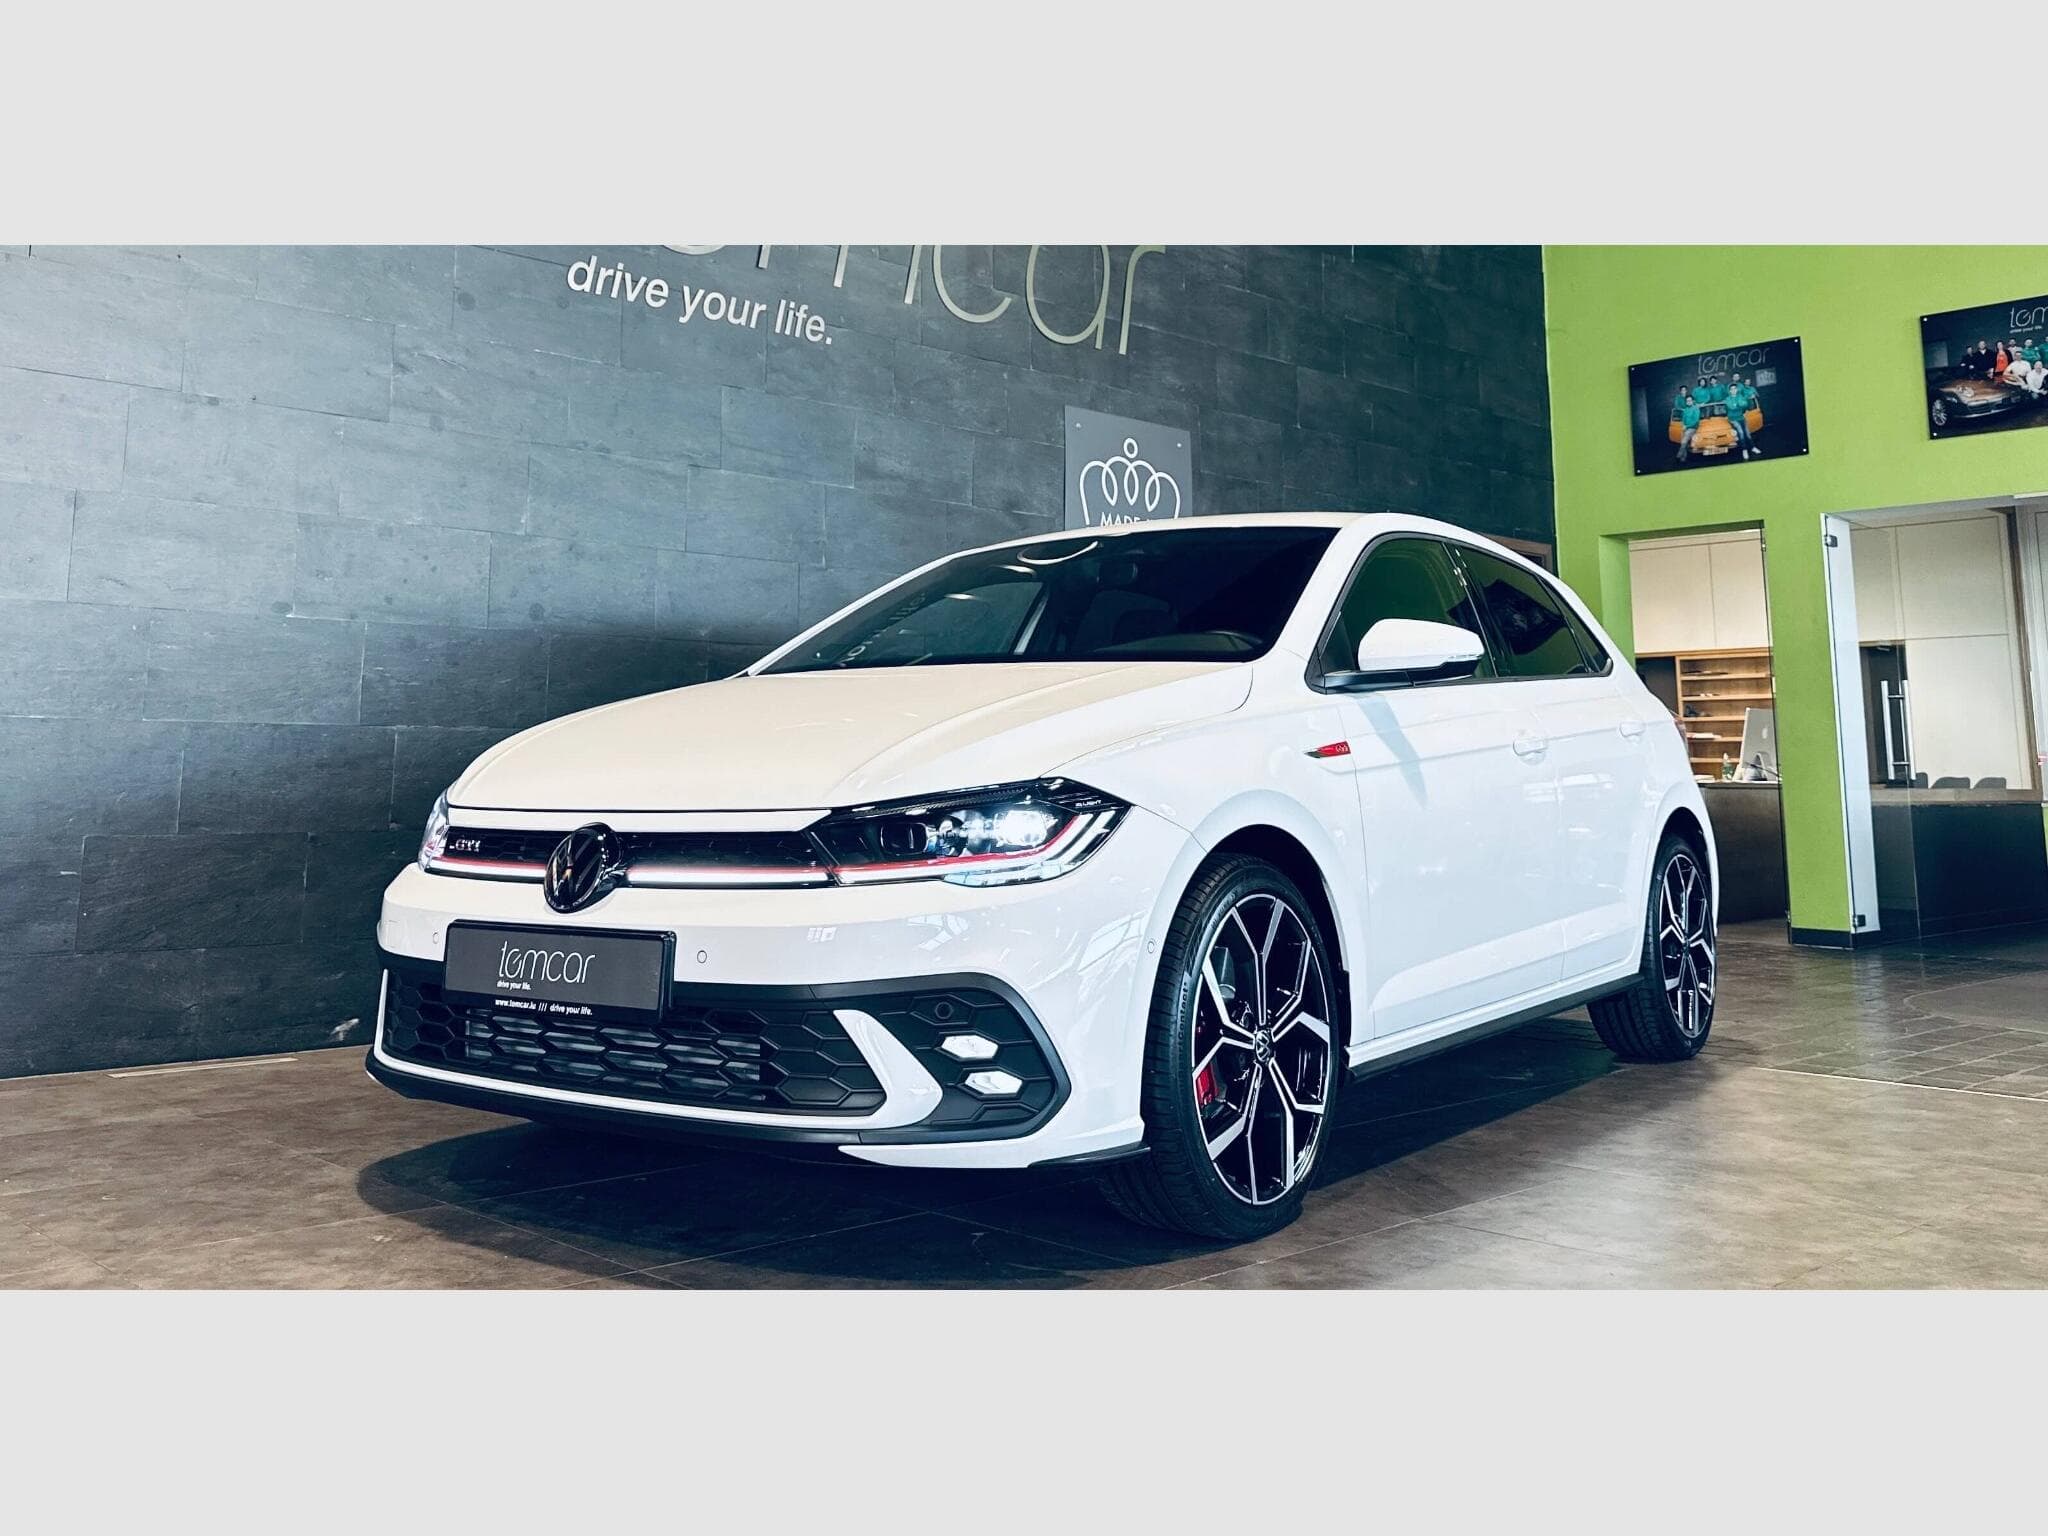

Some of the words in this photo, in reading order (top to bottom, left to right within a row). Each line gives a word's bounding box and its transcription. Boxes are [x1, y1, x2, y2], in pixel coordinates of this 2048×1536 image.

[566, 254, 670, 309] drive
[677, 284, 768, 325] your
[774, 298, 834, 346] life.
[2009, 306, 2048, 328] tom
[1697, 346, 1771, 376] tomcar
[499, 940, 596, 984] tomcar
[497, 980, 510, 989] drive
[510, 982, 522, 990] your
[549, 1004, 565, 1013] drive
[566, 1006, 580, 1015] your
